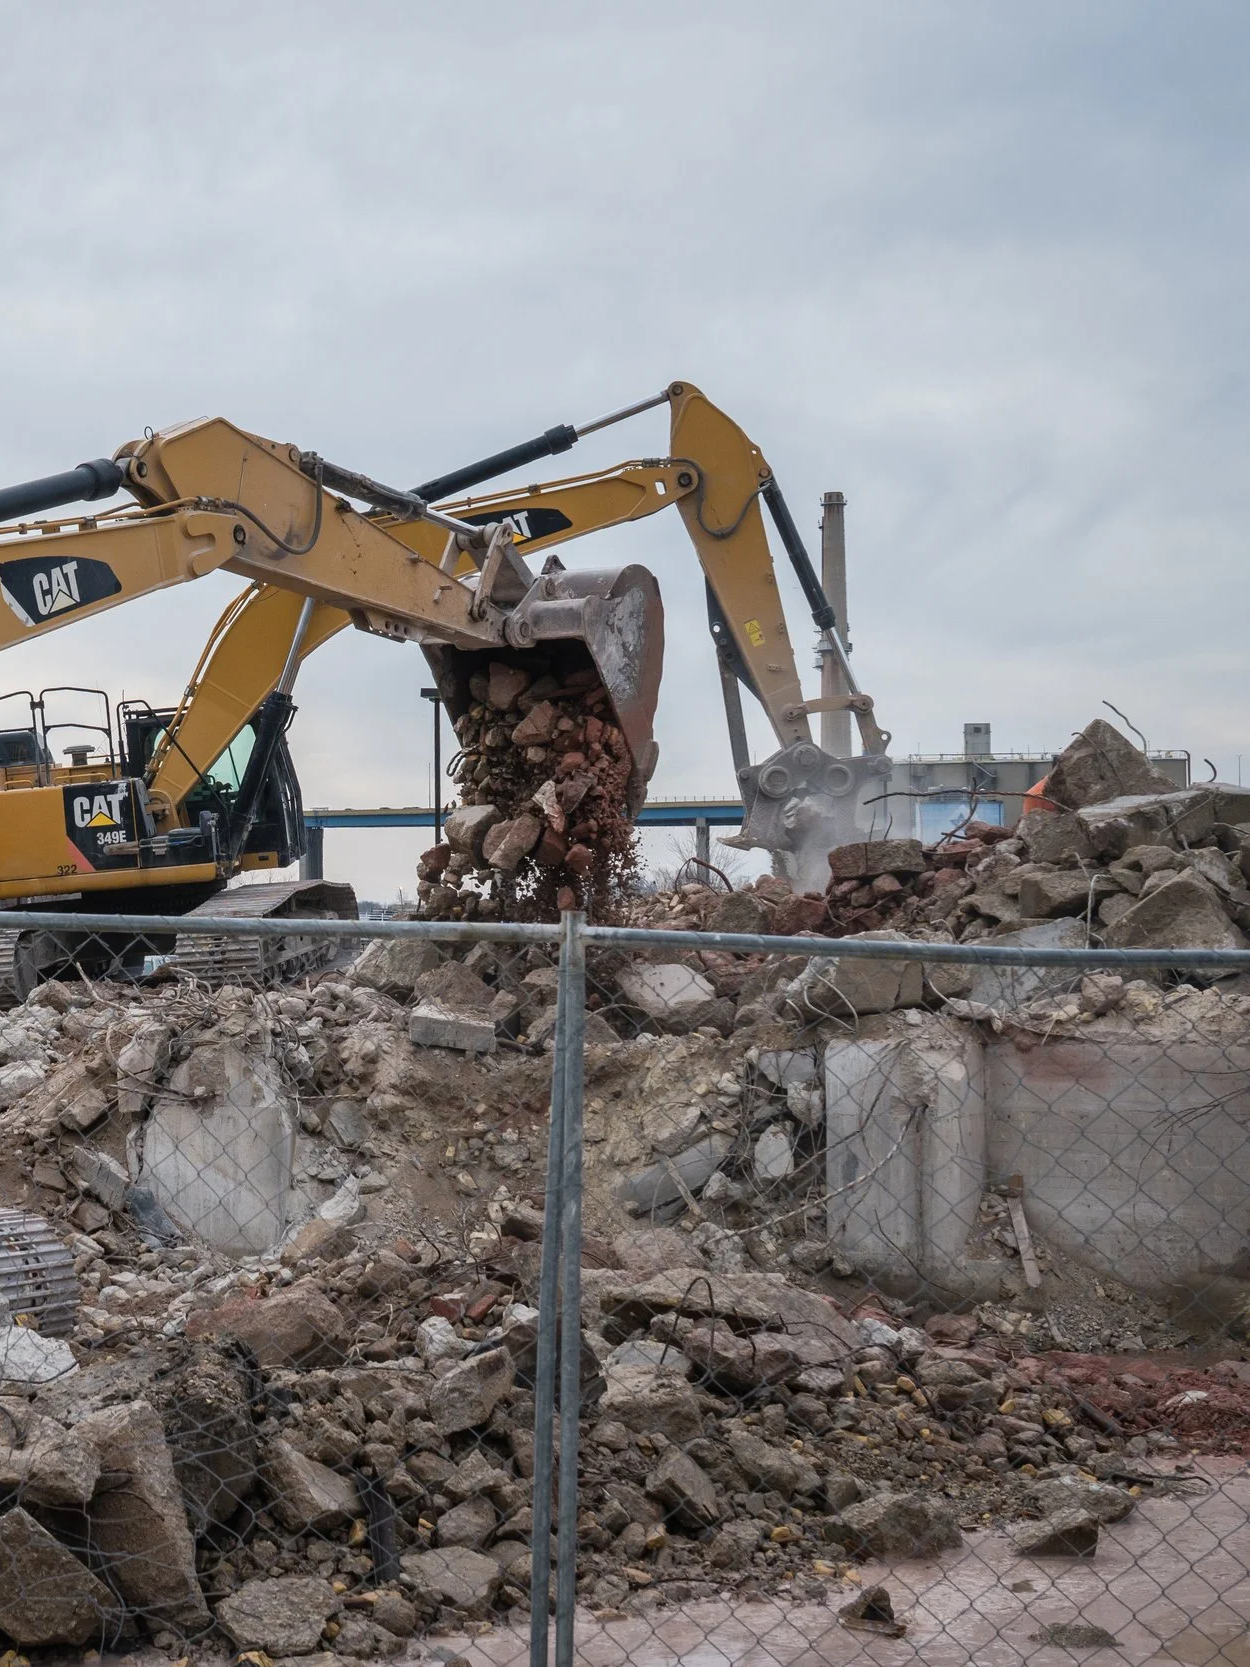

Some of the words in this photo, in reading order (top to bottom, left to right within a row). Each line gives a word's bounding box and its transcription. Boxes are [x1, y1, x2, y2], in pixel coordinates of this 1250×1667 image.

[502, 510, 532, 539] AT
[32, 560, 81, 616] CAT
[73, 794, 124, 828] CAT
[96, 830, 127, 845] 349E
[57, 864, 78, 875] 322
